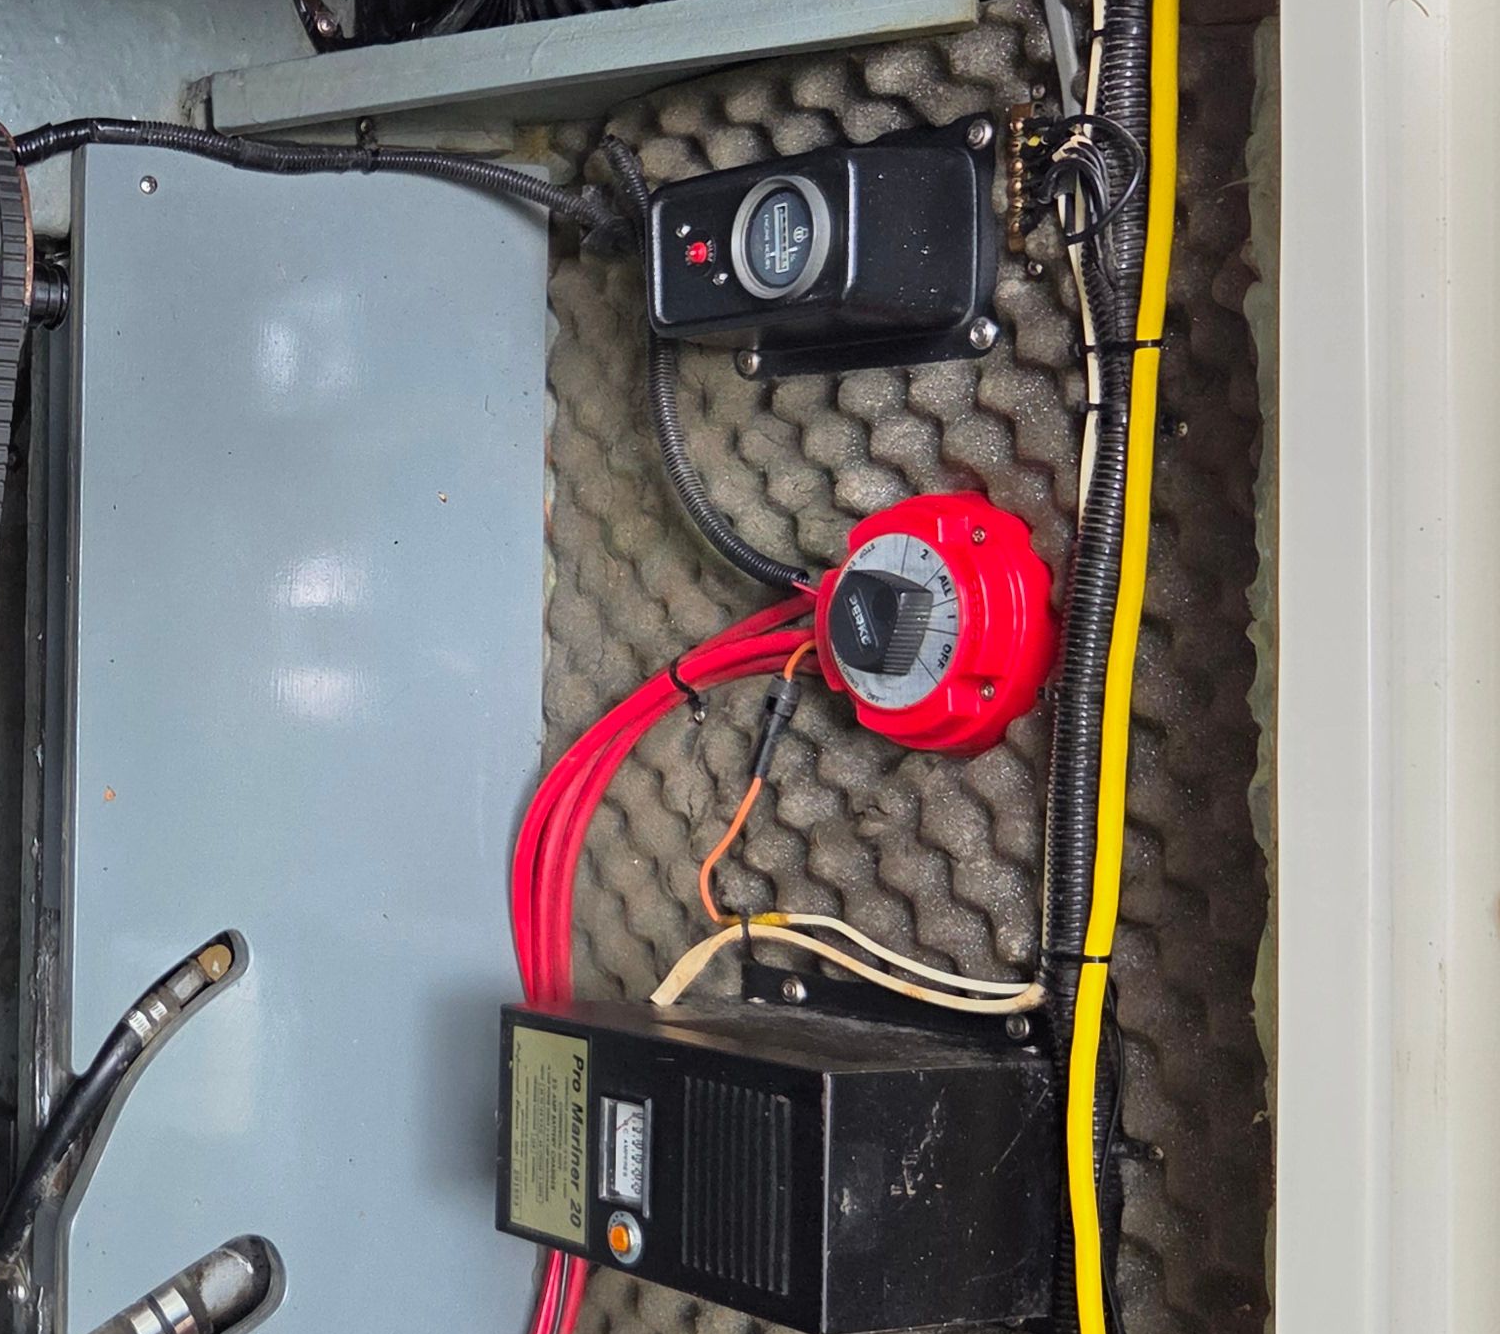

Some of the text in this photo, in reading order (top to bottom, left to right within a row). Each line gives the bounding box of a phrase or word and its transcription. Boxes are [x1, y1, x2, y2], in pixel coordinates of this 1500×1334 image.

[919, 548, 930, 561] 2
[937, 573, 952, 597] ALL
[937, 642, 953, 670] OFF
[570, 1054, 585, 1228] Pro Mariner 20
